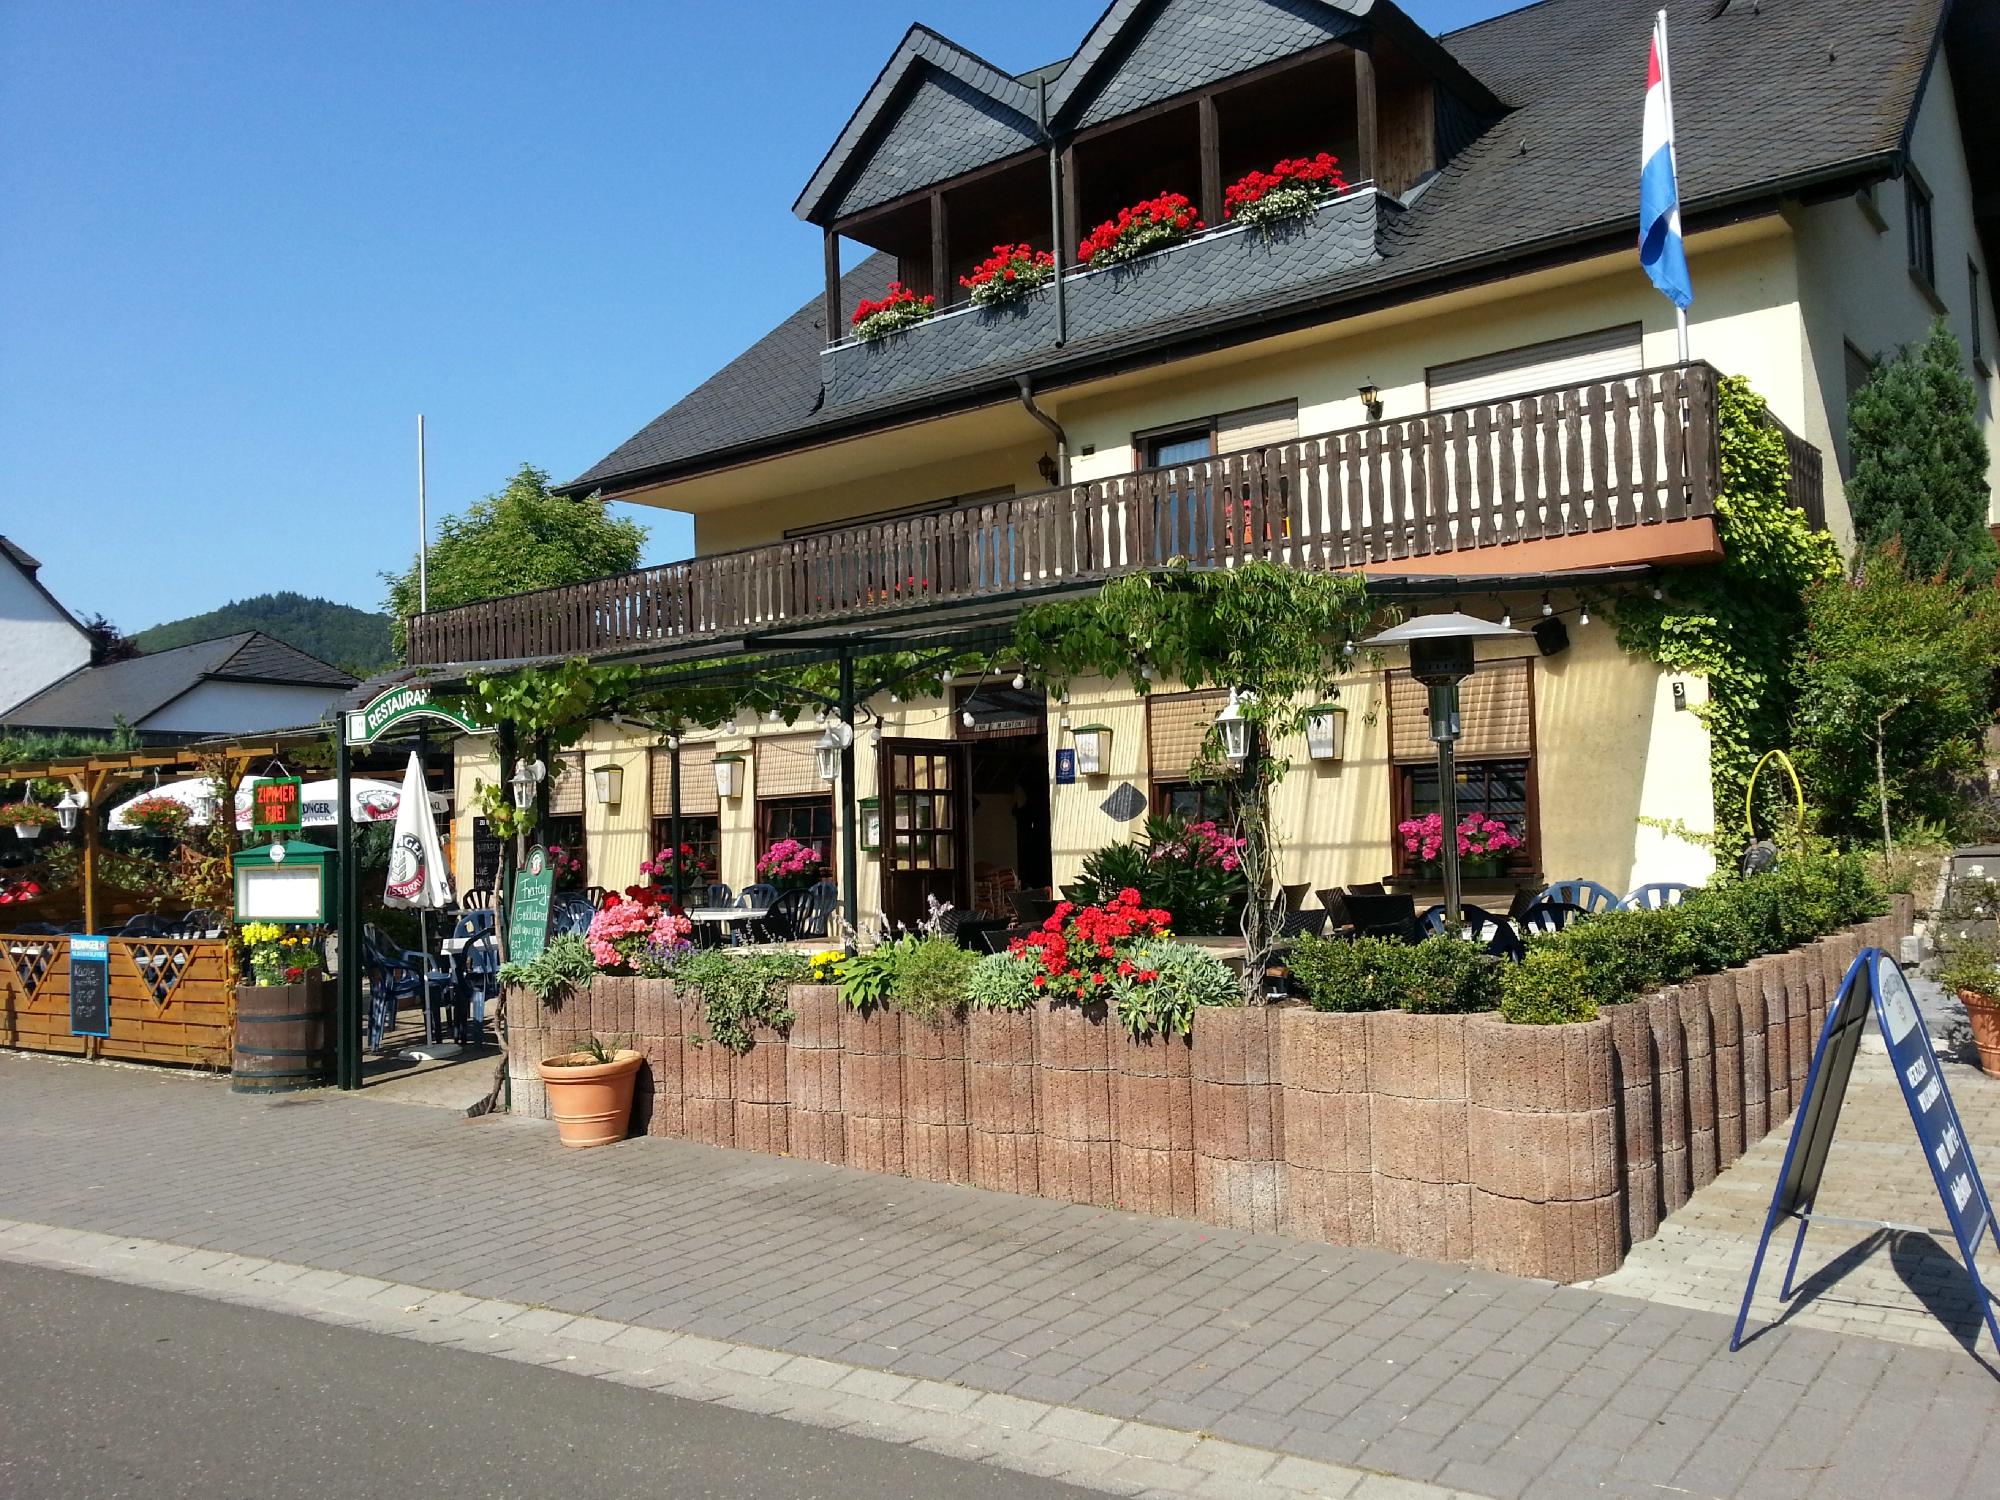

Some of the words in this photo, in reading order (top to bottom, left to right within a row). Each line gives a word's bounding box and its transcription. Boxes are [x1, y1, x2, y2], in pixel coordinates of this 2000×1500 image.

[1674, 684, 1684, 696] 3
[257, 784, 295, 803] ZIMMER
[265, 805, 286, 823] FREI
